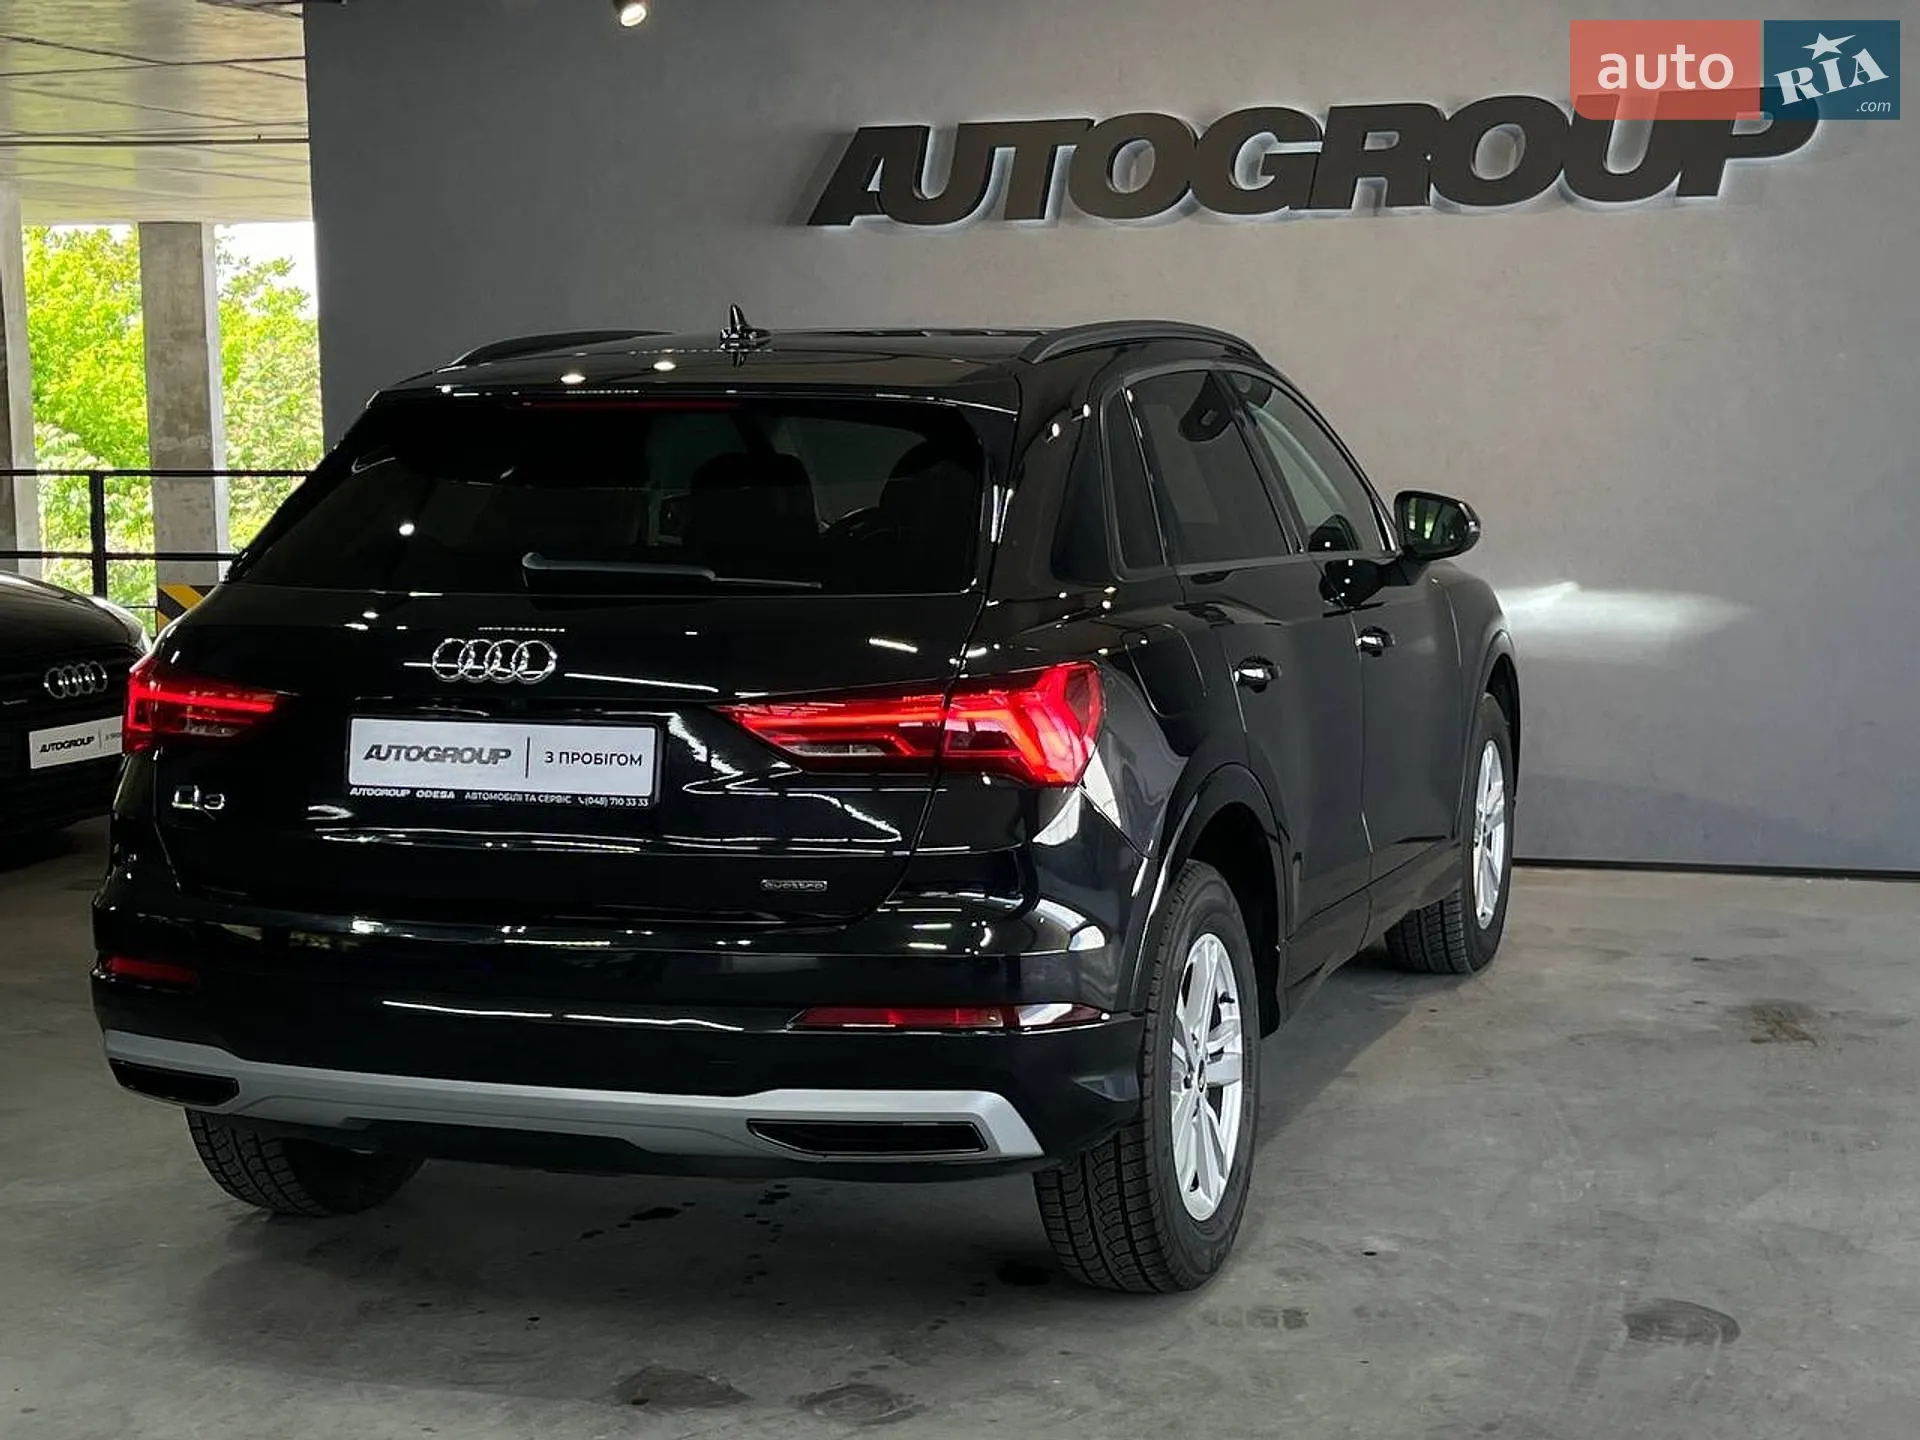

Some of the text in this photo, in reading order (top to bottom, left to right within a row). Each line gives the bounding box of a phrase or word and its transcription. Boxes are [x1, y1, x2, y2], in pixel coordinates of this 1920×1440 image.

[808, 88, 1821, 227] AUTOGROUP
[40, 736, 94, 753] AUTOGROUP
[363, 743, 512, 765] AUTOGROUP
[559, 751, 643, 767] ПРОБІГОМ
[349, 787, 455, 799] AUTOGROUP ODESA
